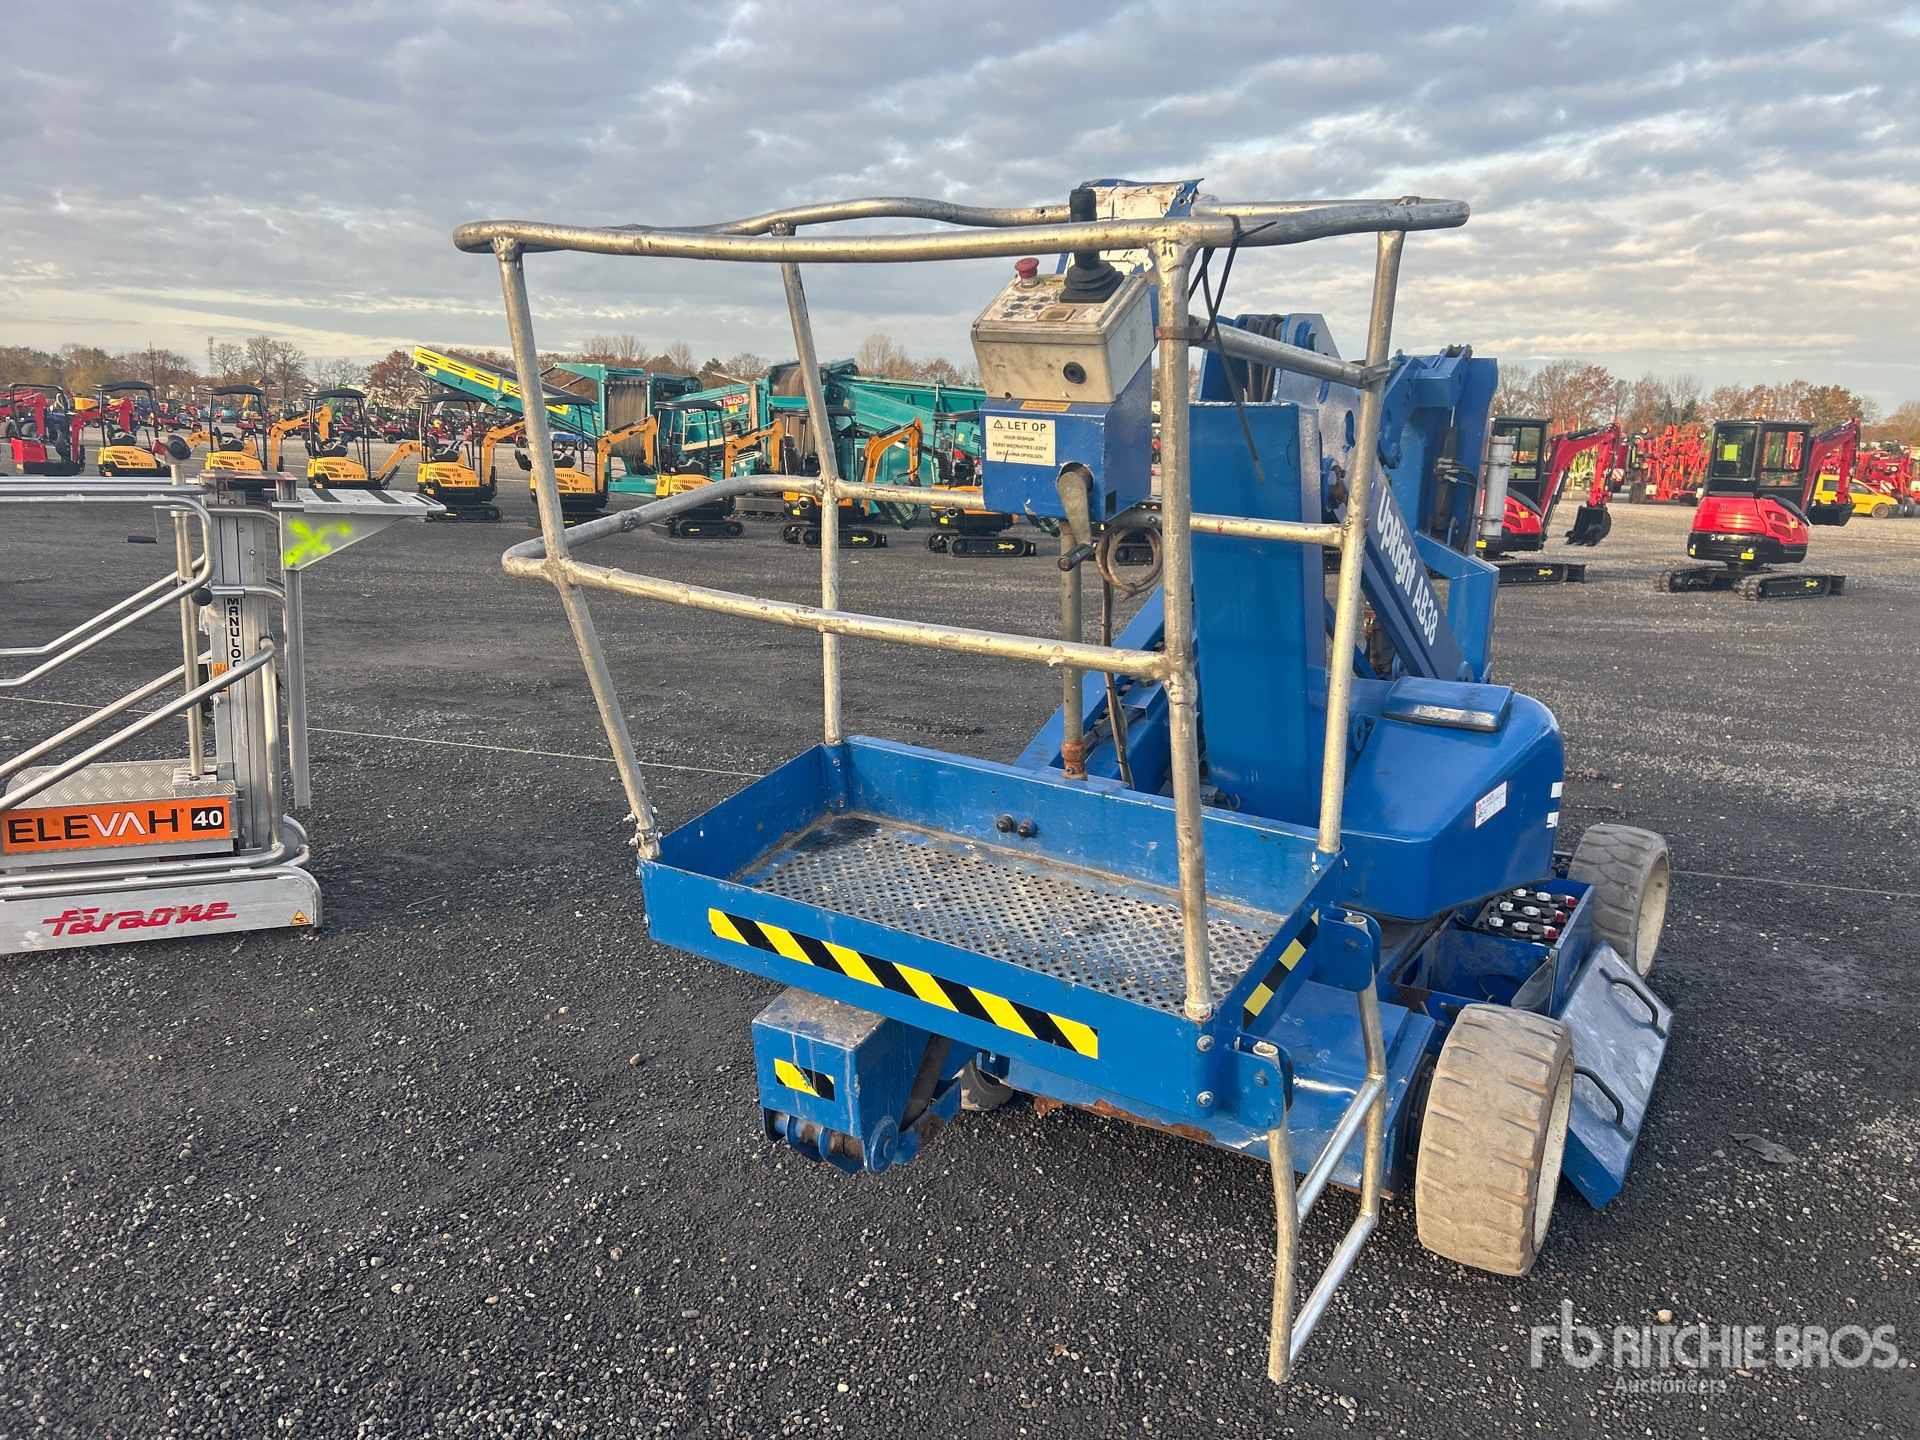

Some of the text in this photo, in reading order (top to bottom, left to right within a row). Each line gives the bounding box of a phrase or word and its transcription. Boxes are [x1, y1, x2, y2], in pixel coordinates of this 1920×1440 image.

[725, 397, 743, 406] 1400
[1007, 421, 1046, 432] LET OP
[1376, 486, 1439, 646] UpRight AB38
[8, 808, 223, 844] ELEVAH 40
